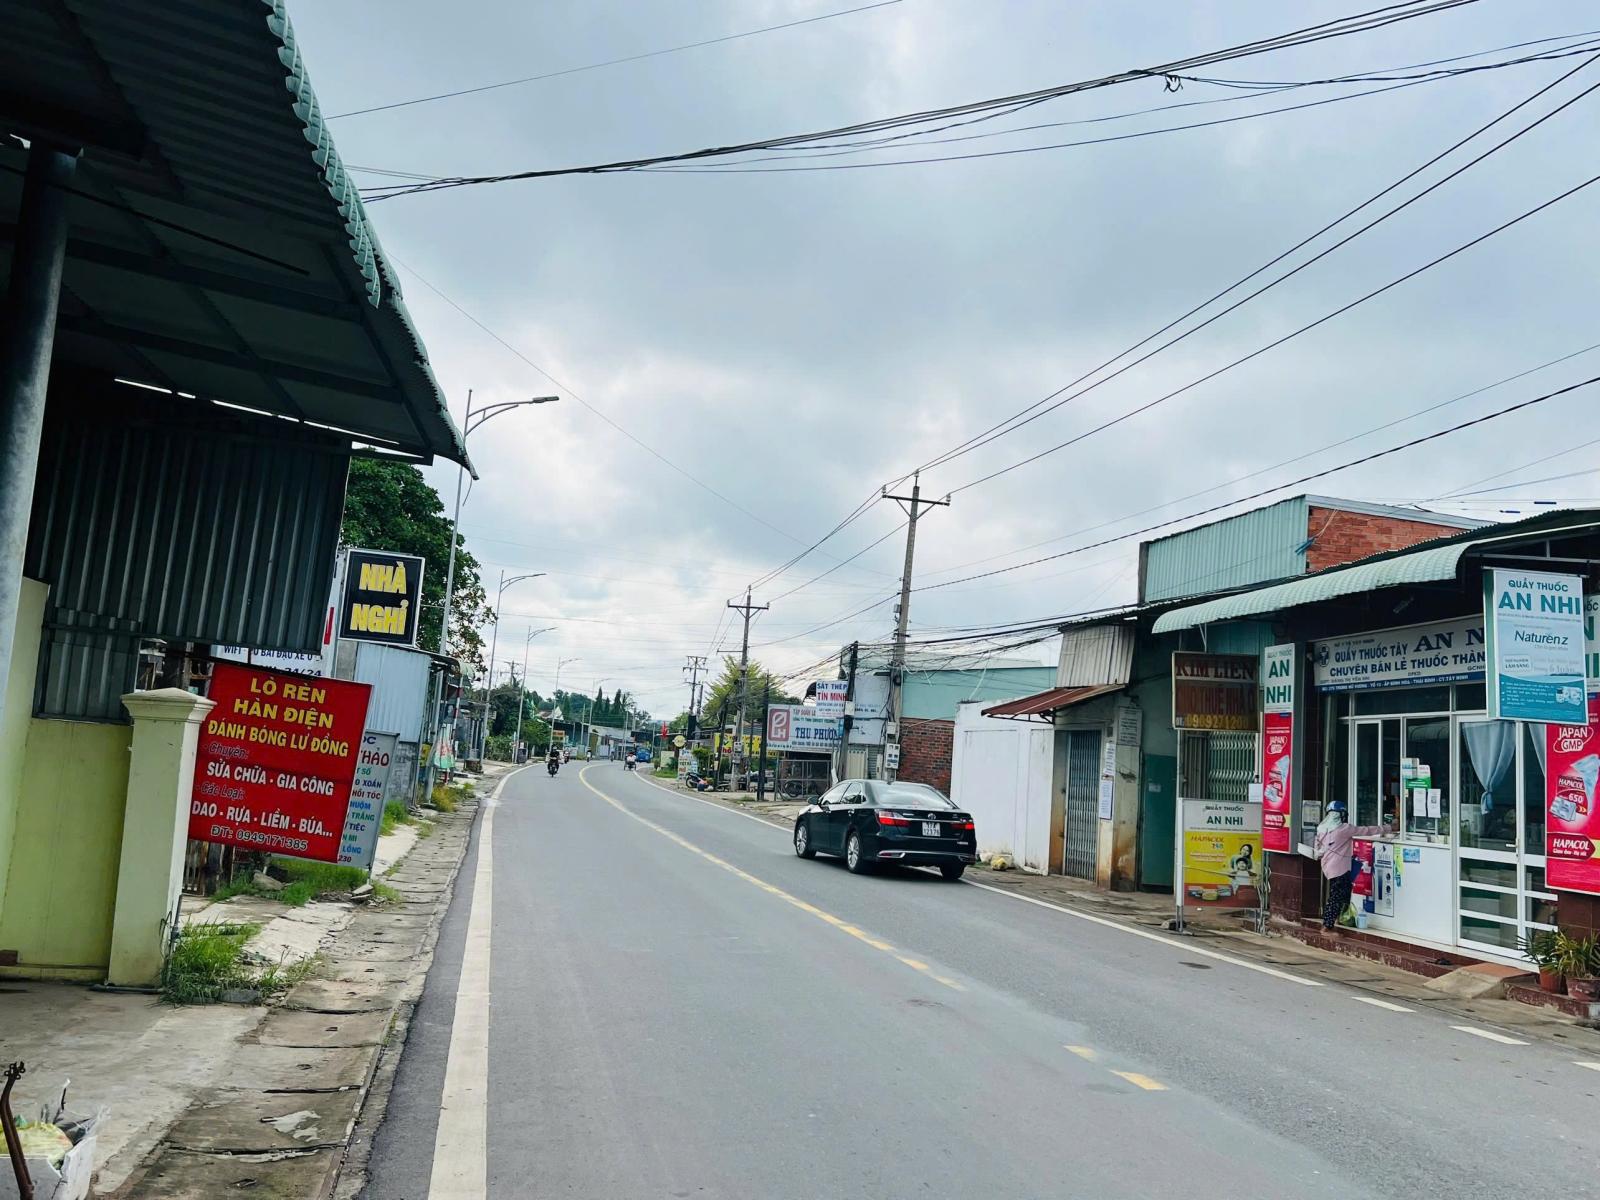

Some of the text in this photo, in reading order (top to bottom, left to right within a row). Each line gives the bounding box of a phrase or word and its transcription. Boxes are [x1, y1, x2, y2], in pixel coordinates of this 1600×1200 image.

[359, 561, 407, 594] NHÀ
[1537, 581, 1568, 592] THUỐC
[1498, 592, 1581, 616] AN NHI
[350, 599, 409, 635] NGHỈ
[1360, 642, 1388, 659] THUỐC
[1390, 642, 1408, 656] TÂY
[1413, 631, 1454, 652] AN
[1514, 630, 1568, 646] Naturenz
[1175, 662, 1209, 678] KIM
[1268, 659, 1290, 678] AN
[1330, 663, 1368, 677] CHUYÊN
[1411, 652, 1448, 669] THUỐC
[251, 676, 325, 704] LÒ RÈN
[830, 692, 849, 701] MINH
[1266, 684, 1292, 703] NHI
[233, 696, 334, 730] HÀN ĐIỆN
[208, 717, 247, 740] ĐÁNH
[249, 724, 286, 747] BÓNG
[290, 732, 309, 751] LƯ
[795, 727, 811, 739] THU
[1558, 727, 1587, 741] JAPAN
[1562, 740, 1582, 750] GMP
[361, 747, 389, 766] HẢO
[207, 758, 334, 796] SỬA CHỮA GIA CÔNG
[1559, 778, 1584, 789] HAPACOL
[367, 790, 381, 799] TÓC
[1568, 793, 1583, 804] 650
[192, 800, 217, 818] DAO
[226, 805, 251, 826] RỰA
[260, 808, 290, 830] LIỀM
[1206, 815, 1243, 826] AN NHI
[211, 824, 308, 851] ĐT: 0949171385
[1553, 838, 1590, 850] HAPACOL
